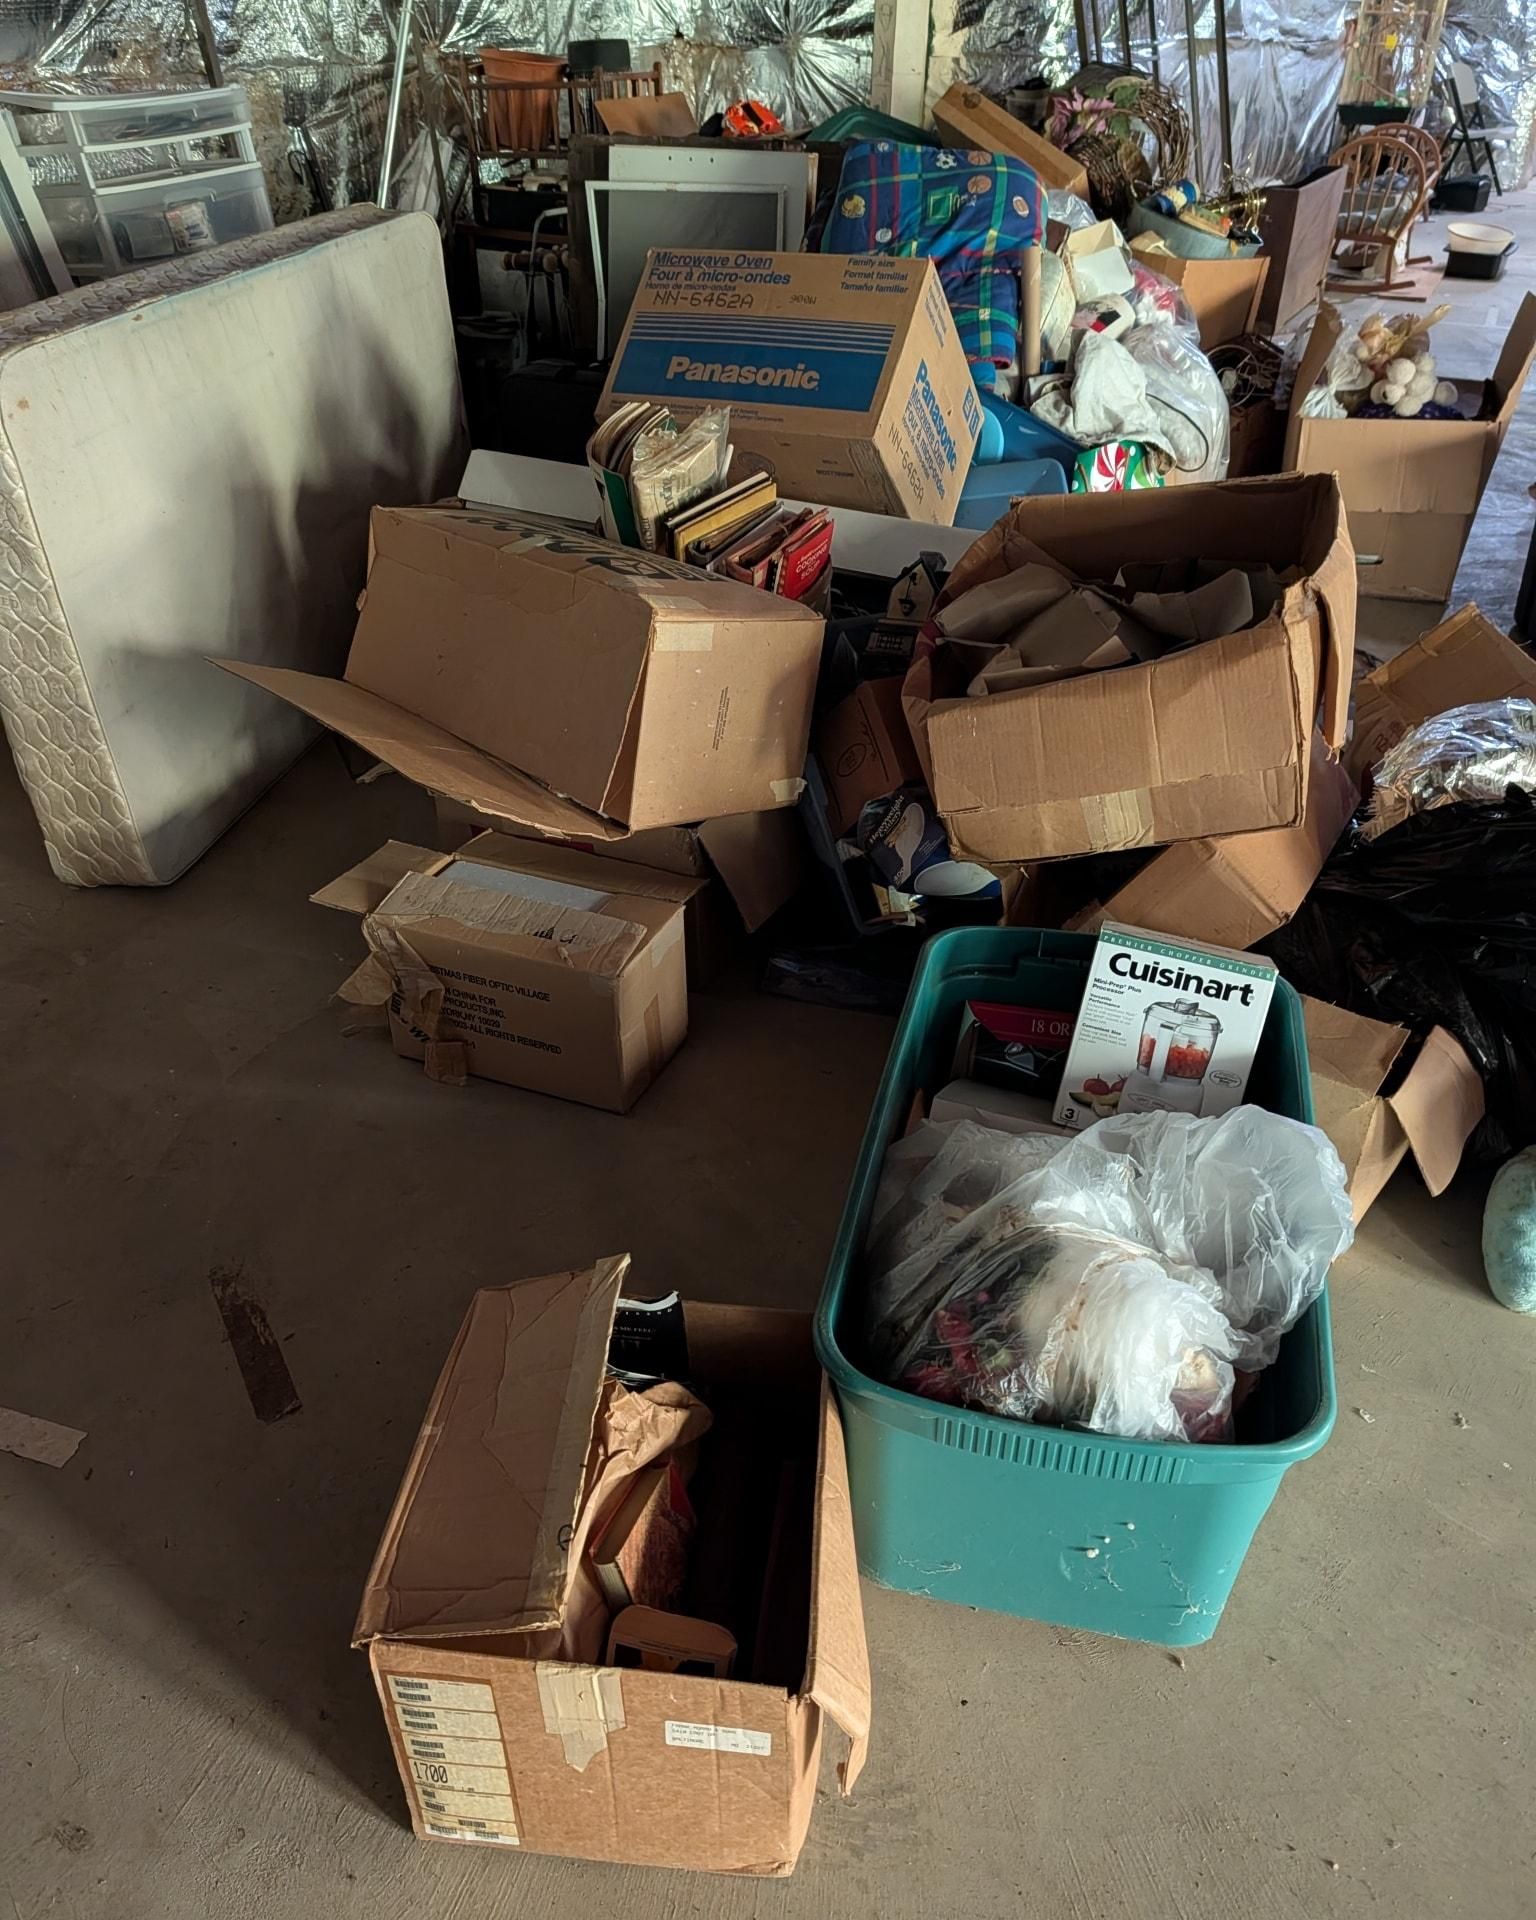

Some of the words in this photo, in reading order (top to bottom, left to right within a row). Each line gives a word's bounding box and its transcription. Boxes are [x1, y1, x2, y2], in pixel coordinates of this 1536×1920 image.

[654, 252, 730, 267] Microwave
[734, 255, 774, 269] Oven
[848, 258, 876, 268] Family
[878, 259, 896, 267] size
[648, 267, 681, 281] Four
[697, 269, 792, 285] micro-ondes
[843, 270, 874, 279] Format
[653, 291, 754, 309] NN-6462A
[666, 356, 820, 390] Panasonic
[904, 402, 918, 431] Four
[909, 384, 936, 446] Microwave
[915, 358, 957, 473] Panasonic
[889, 422, 925, 505] NN-6462A
[1103, 935, 1152, 951] PREMIER
[1161, 948, 1212, 965] CHOPPER
[1219, 962, 1272, 979] GRINDER
[463, 973, 488, 987] FIBER
[489, 979, 514, 993] OPTIC
[515, 985, 551, 1002] VILLAGE
[1092, 983, 1124, 995] Processor
[1109, 952, 1254, 1007] Cuisinart
[1128, 985, 1141, 993] Plus
[452, 988, 477, 1002] CHINA
[478, 995, 497, 1007] FOR
[1032, 1019, 1045, 1033] 18
[485, 1027, 516, 1042] RIGHTS
[517, 1036, 562, 1054] RESERVED
[1065, 1108, 1074, 1120] 3
[413, 1761, 449, 1784] 1700
